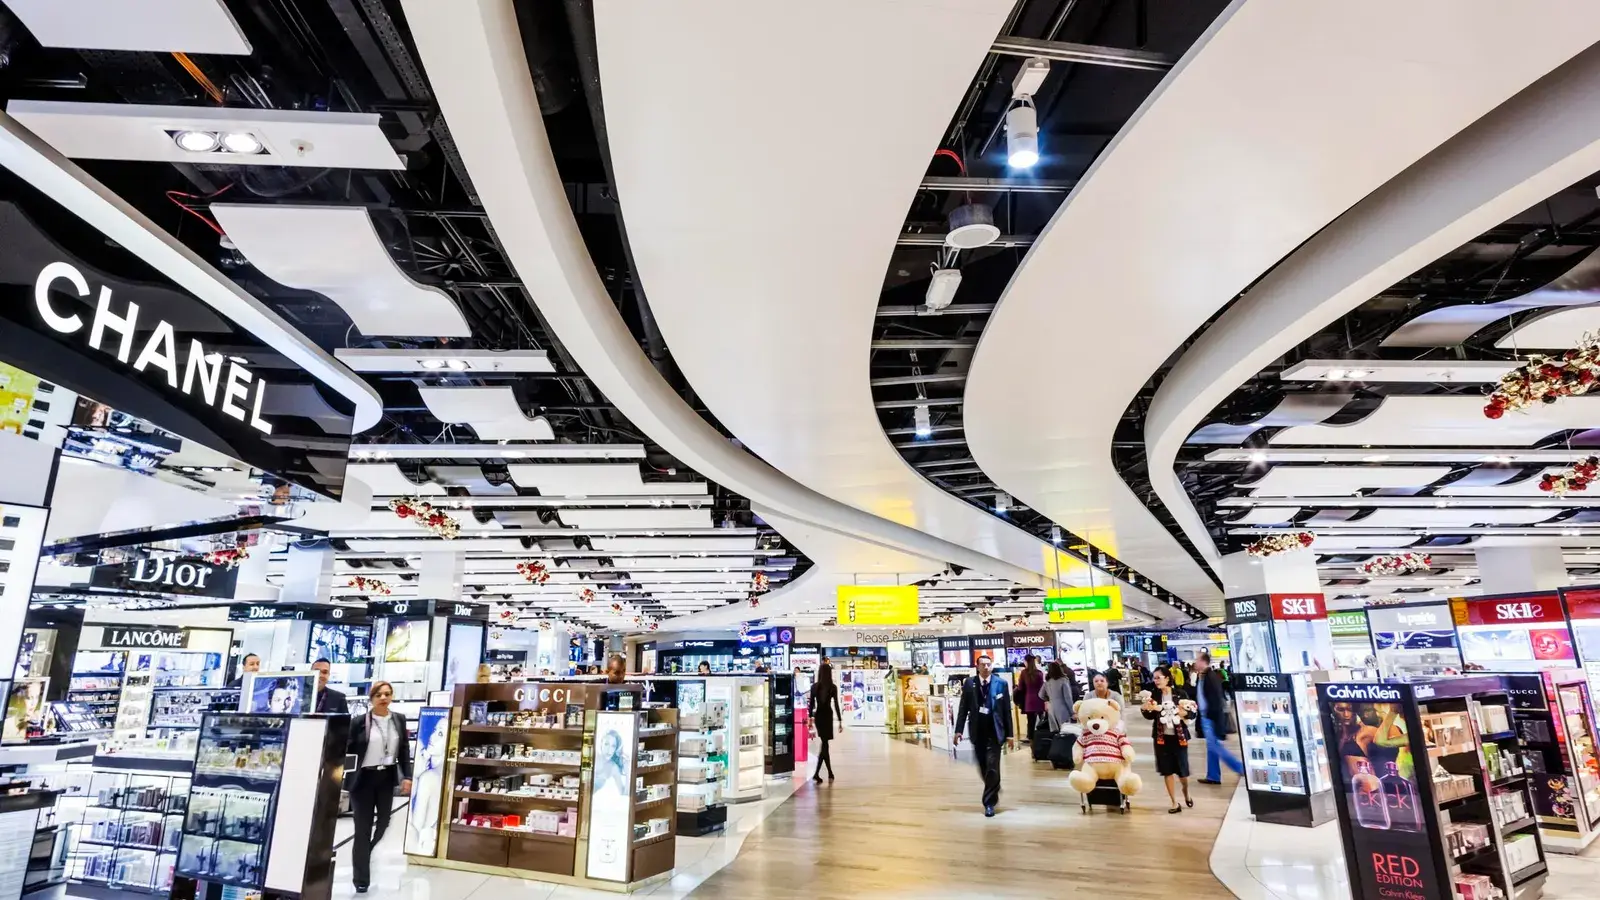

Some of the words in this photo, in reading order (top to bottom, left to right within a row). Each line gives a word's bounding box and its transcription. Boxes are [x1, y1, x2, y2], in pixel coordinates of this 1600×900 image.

[35, 262, 273, 434] CHANEL
[130, 555, 212, 588] Dior
[249, 606, 275, 618] Dior
[455, 604, 472, 616] Dior
[1234, 600, 1257, 614] BOSS
[1282, 598, 1317, 615] SK-II
[1496, 602, 1533, 620] SK-II
[111, 630, 181, 646] LANCÔME
[856, 632, 889, 644] Please
[1014, 636, 1027, 644] TOM
[1245, 675, 1277, 685] BOSS
[514, 688, 571, 703] GUCCI
[1326, 685, 1367, 699] Calvin
[1367, 685, 1401, 699] Klein
[1372, 853, 1420, 877] RED
[1376, 873, 1423, 888] EDITION
